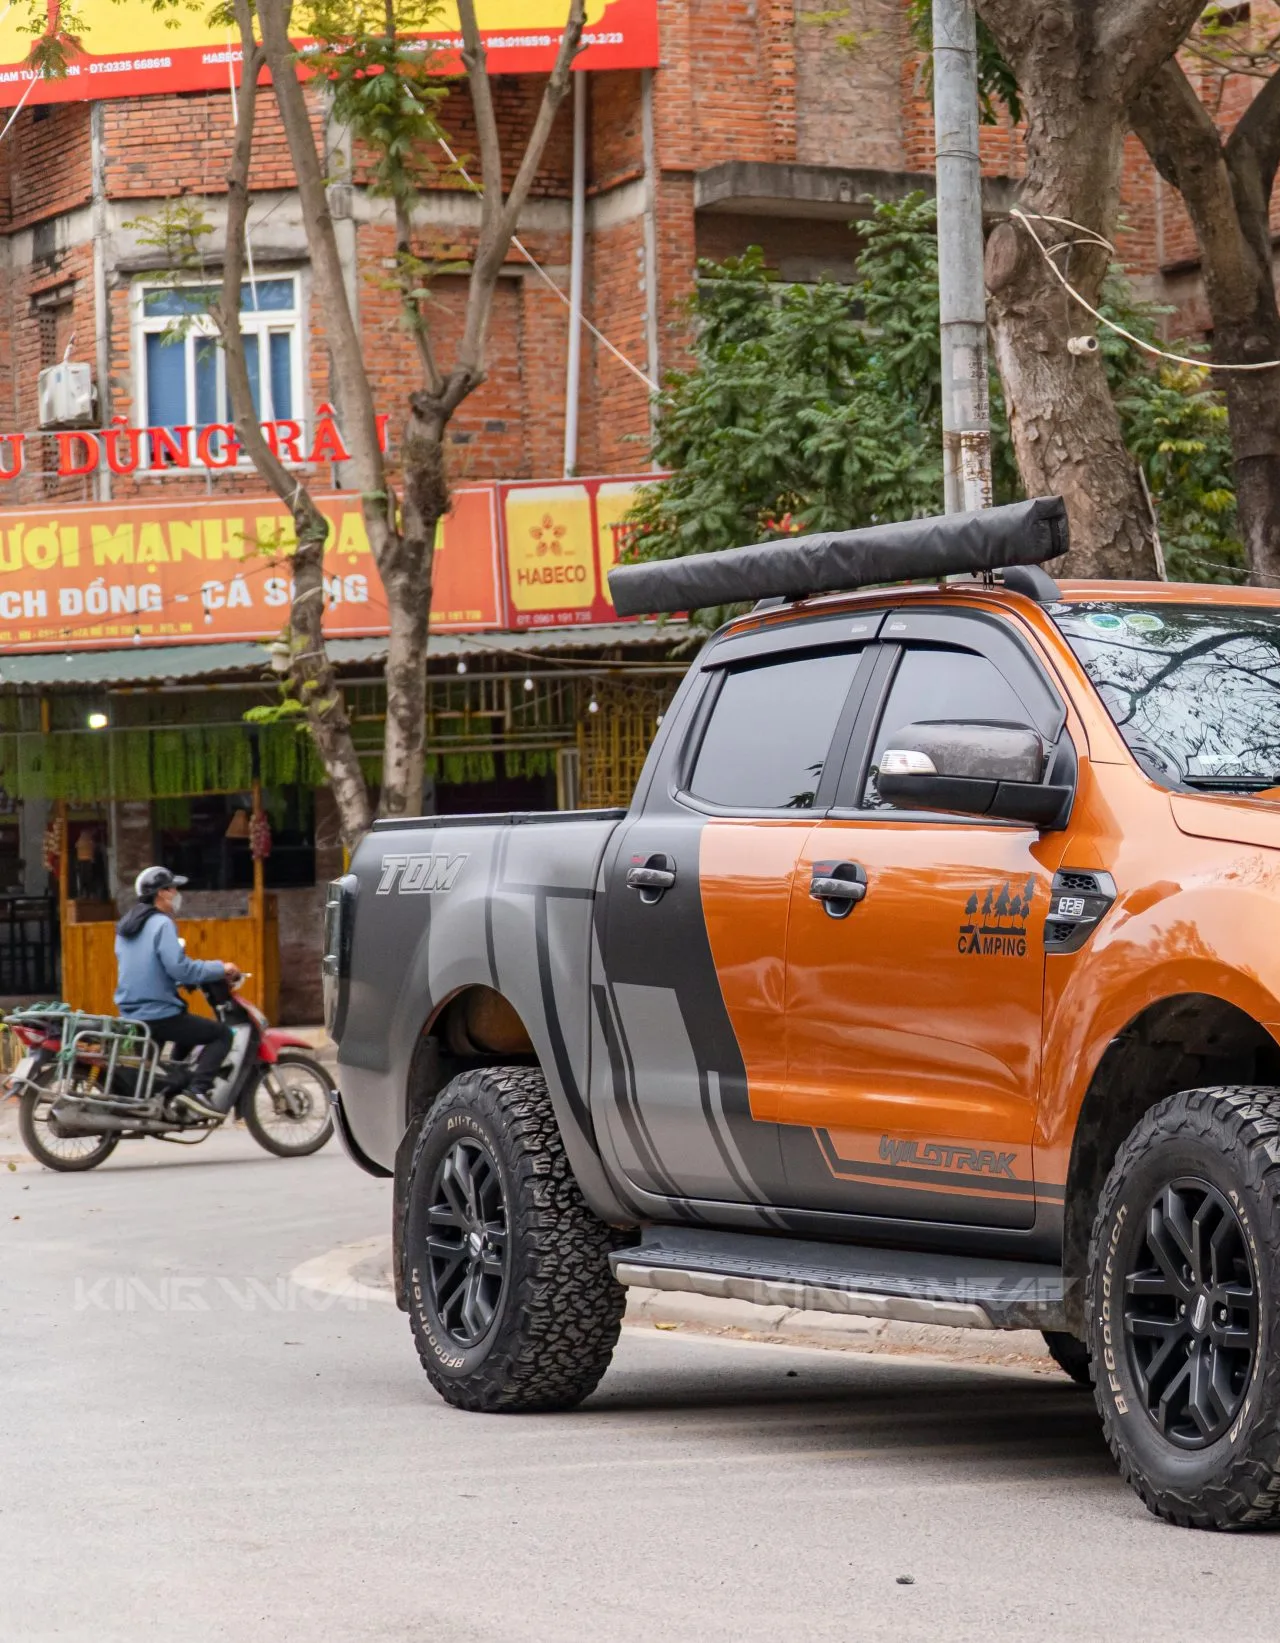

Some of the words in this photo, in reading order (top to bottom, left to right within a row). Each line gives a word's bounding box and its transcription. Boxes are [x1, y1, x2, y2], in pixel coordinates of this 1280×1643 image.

[262, 402, 390, 463] RÂ
[91, 517, 243, 574] MẠNH
[59, 576, 162, 617] ĐỒNG
[202, 573, 253, 609] CÁ
[263, 573, 368, 607] SNG
[517, 565, 586, 585] HABECO
[376, 854, 470, 894] TOM
[957, 925, 1027, 957] CAMPING
